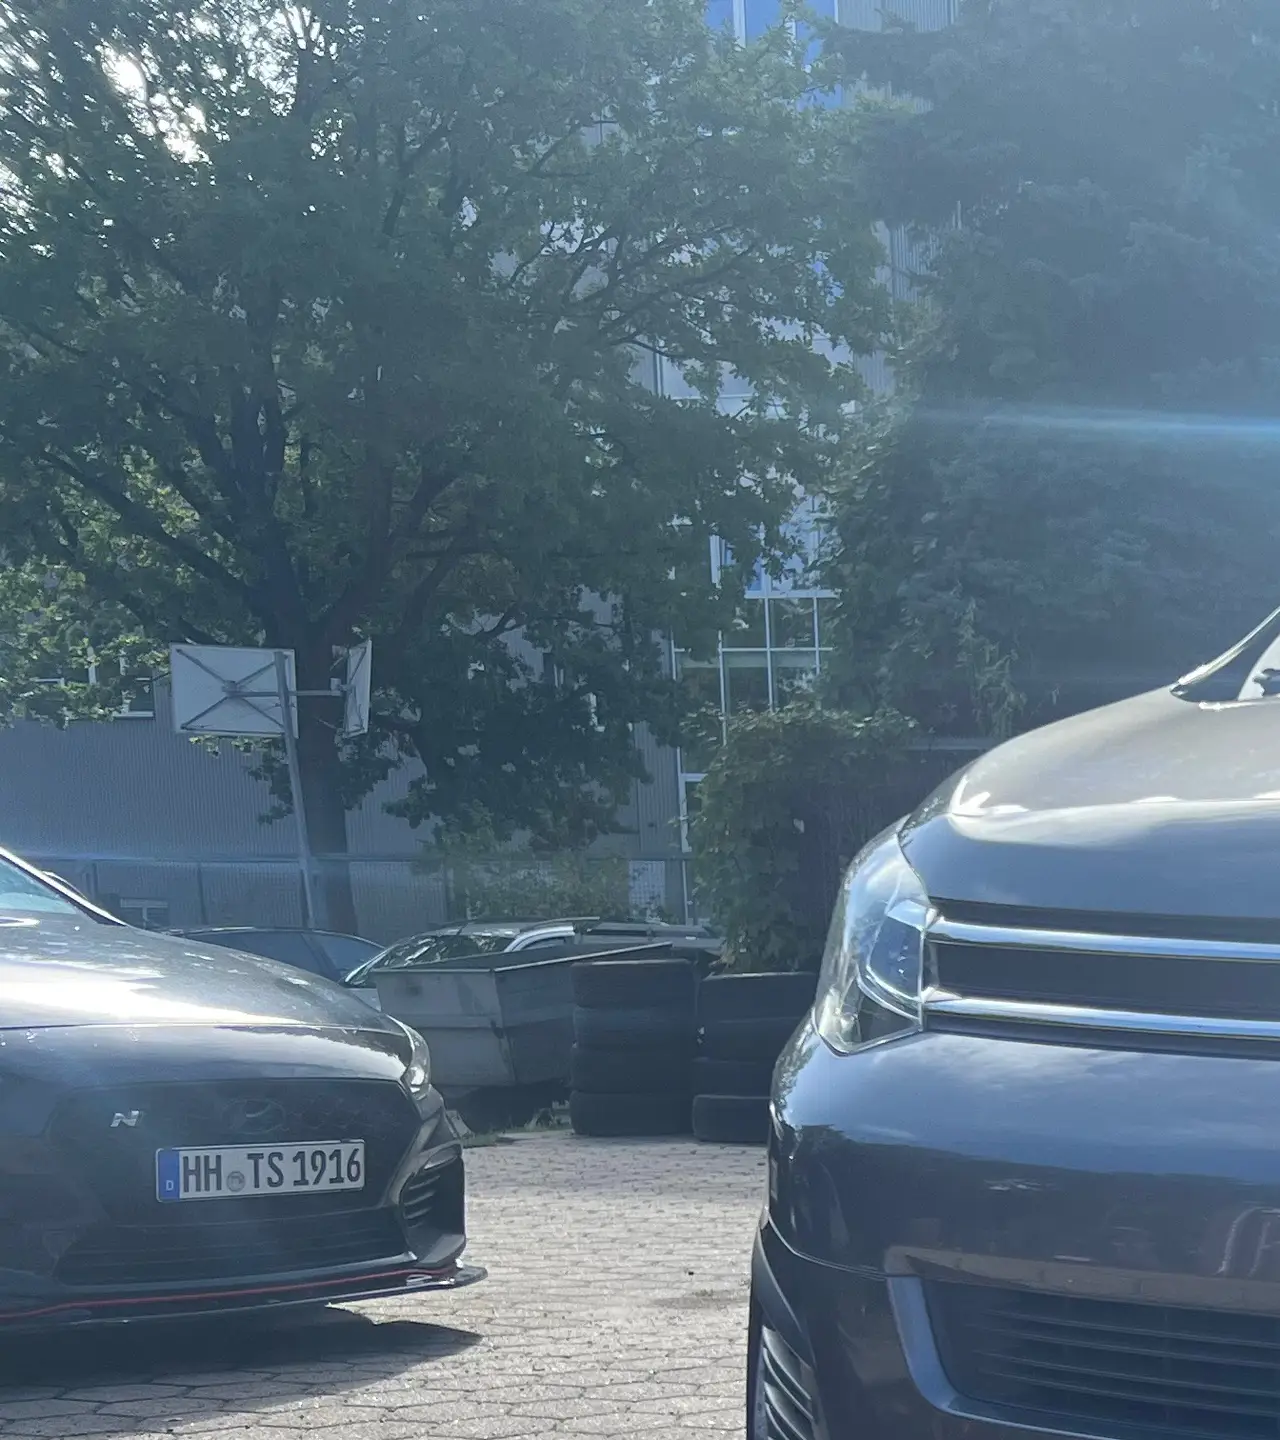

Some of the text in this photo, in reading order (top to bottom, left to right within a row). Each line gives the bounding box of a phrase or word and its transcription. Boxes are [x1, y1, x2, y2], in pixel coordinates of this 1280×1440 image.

[183, 1148, 362, 1193] HH TS 1916
[165, 1179, 175, 1191] D
